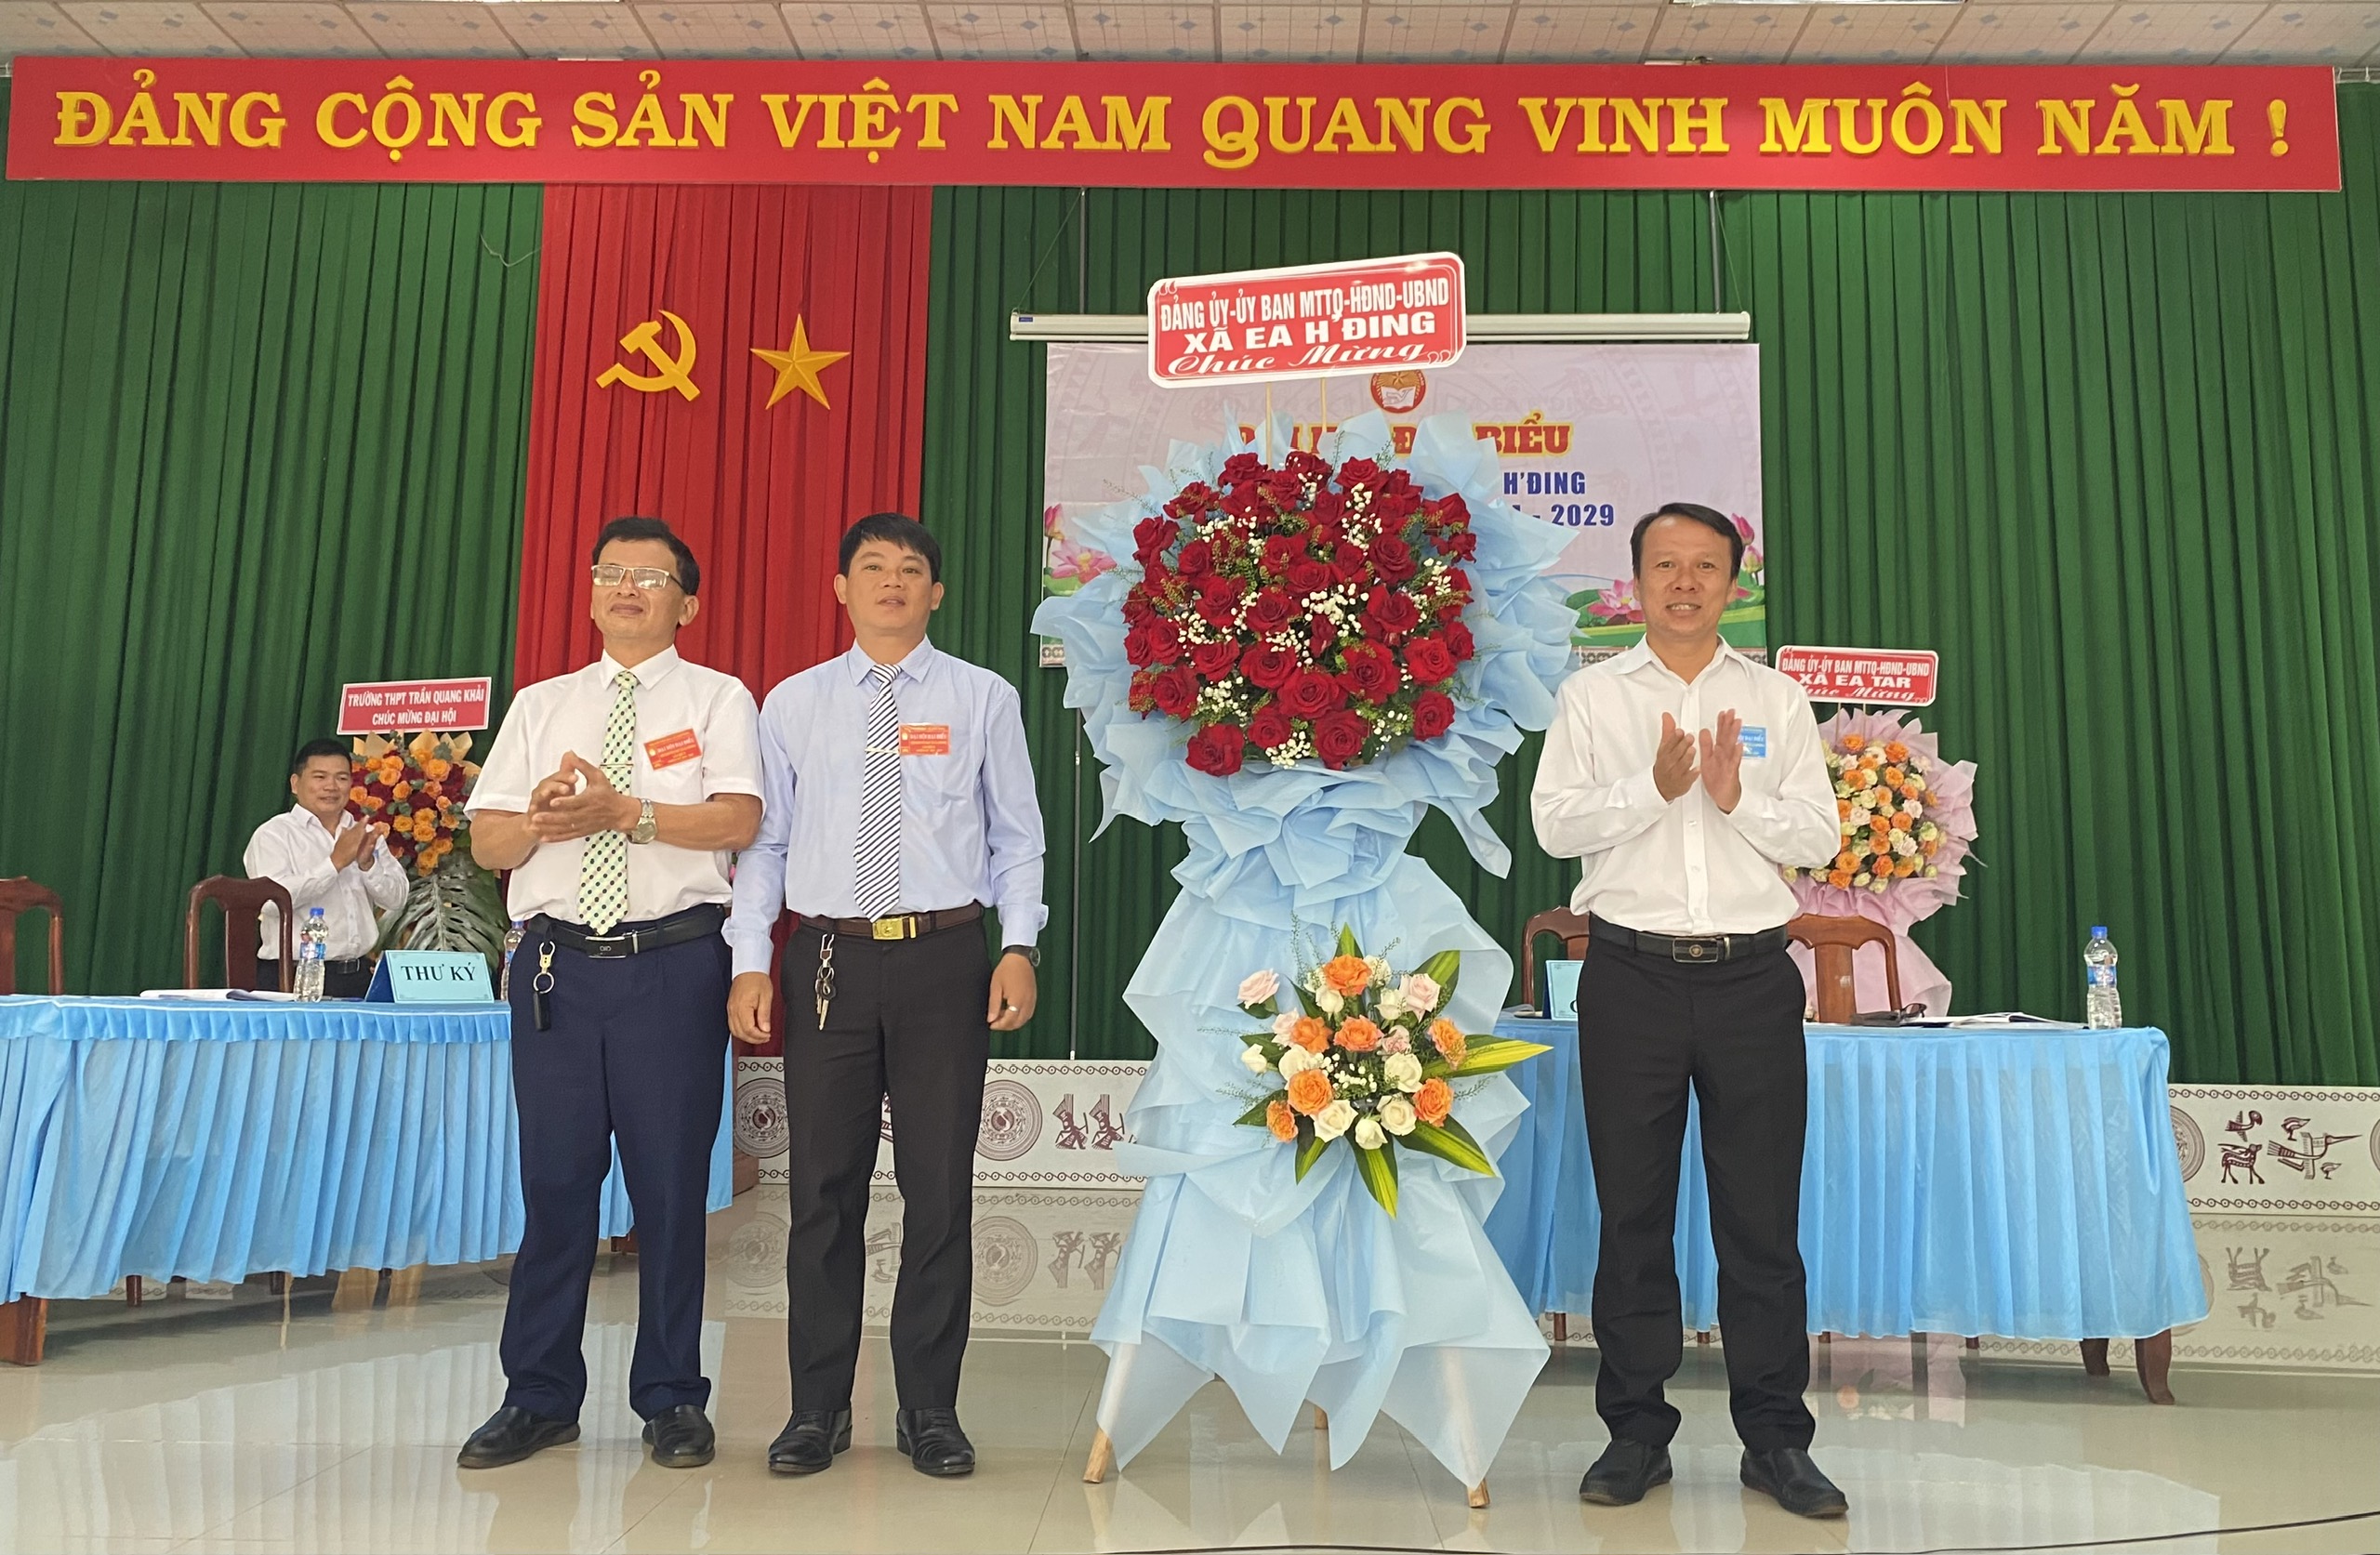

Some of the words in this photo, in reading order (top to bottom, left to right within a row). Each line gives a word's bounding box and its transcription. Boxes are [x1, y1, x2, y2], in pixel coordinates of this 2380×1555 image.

[53, 68, 286, 149] ĐẢNG
[315, 74, 542, 163] CỘNG
[571, 70, 734, 149] SẢN
[760, 76, 959, 164] VIỆT
[986, 94, 1172, 152] NAM
[1202, 96, 1491, 169] QUANG
[1517, 98, 1730, 153] VINH
[1758, 81, 2007, 155] MUÔN
[2036, 83, 2235, 156] NĂM
[2266, 99, 2290, 158] !
[1160, 294, 1206, 332] ĐẢNG
[1209, 288, 1257, 327] ỦY-ỦY
[1261, 292, 1295, 322] BAN
[1183, 326, 1234, 355] XÃ
[1246, 323, 1293, 349] EA
[1168, 354, 1276, 376] Chúc
[1288, 343, 1429, 367] Mừng
[1551, 504, 1615, 527] 2029
[1781, 652, 1806, 672] ĐẢNG
[1834, 659, 1853, 674] BAN
[1799, 672, 1829, 685] XÃ
[1835, 675, 1864, 687] EA
[1871, 676, 1911, 689] TAR
[348, 691, 383, 707] TRƯỜNG
[384, 692, 407, 706] THPT
[433, 689, 462, 705] QUANG
[372, 709, 396, 726] CHÚC
[397, 708, 423, 725] MỪNG
[424, 710, 440, 726] ĐẠI
[442, 706, 456, 726] HỘI
[401, 964, 444, 982] THƯ
[450, 962, 477, 982] KÝ
